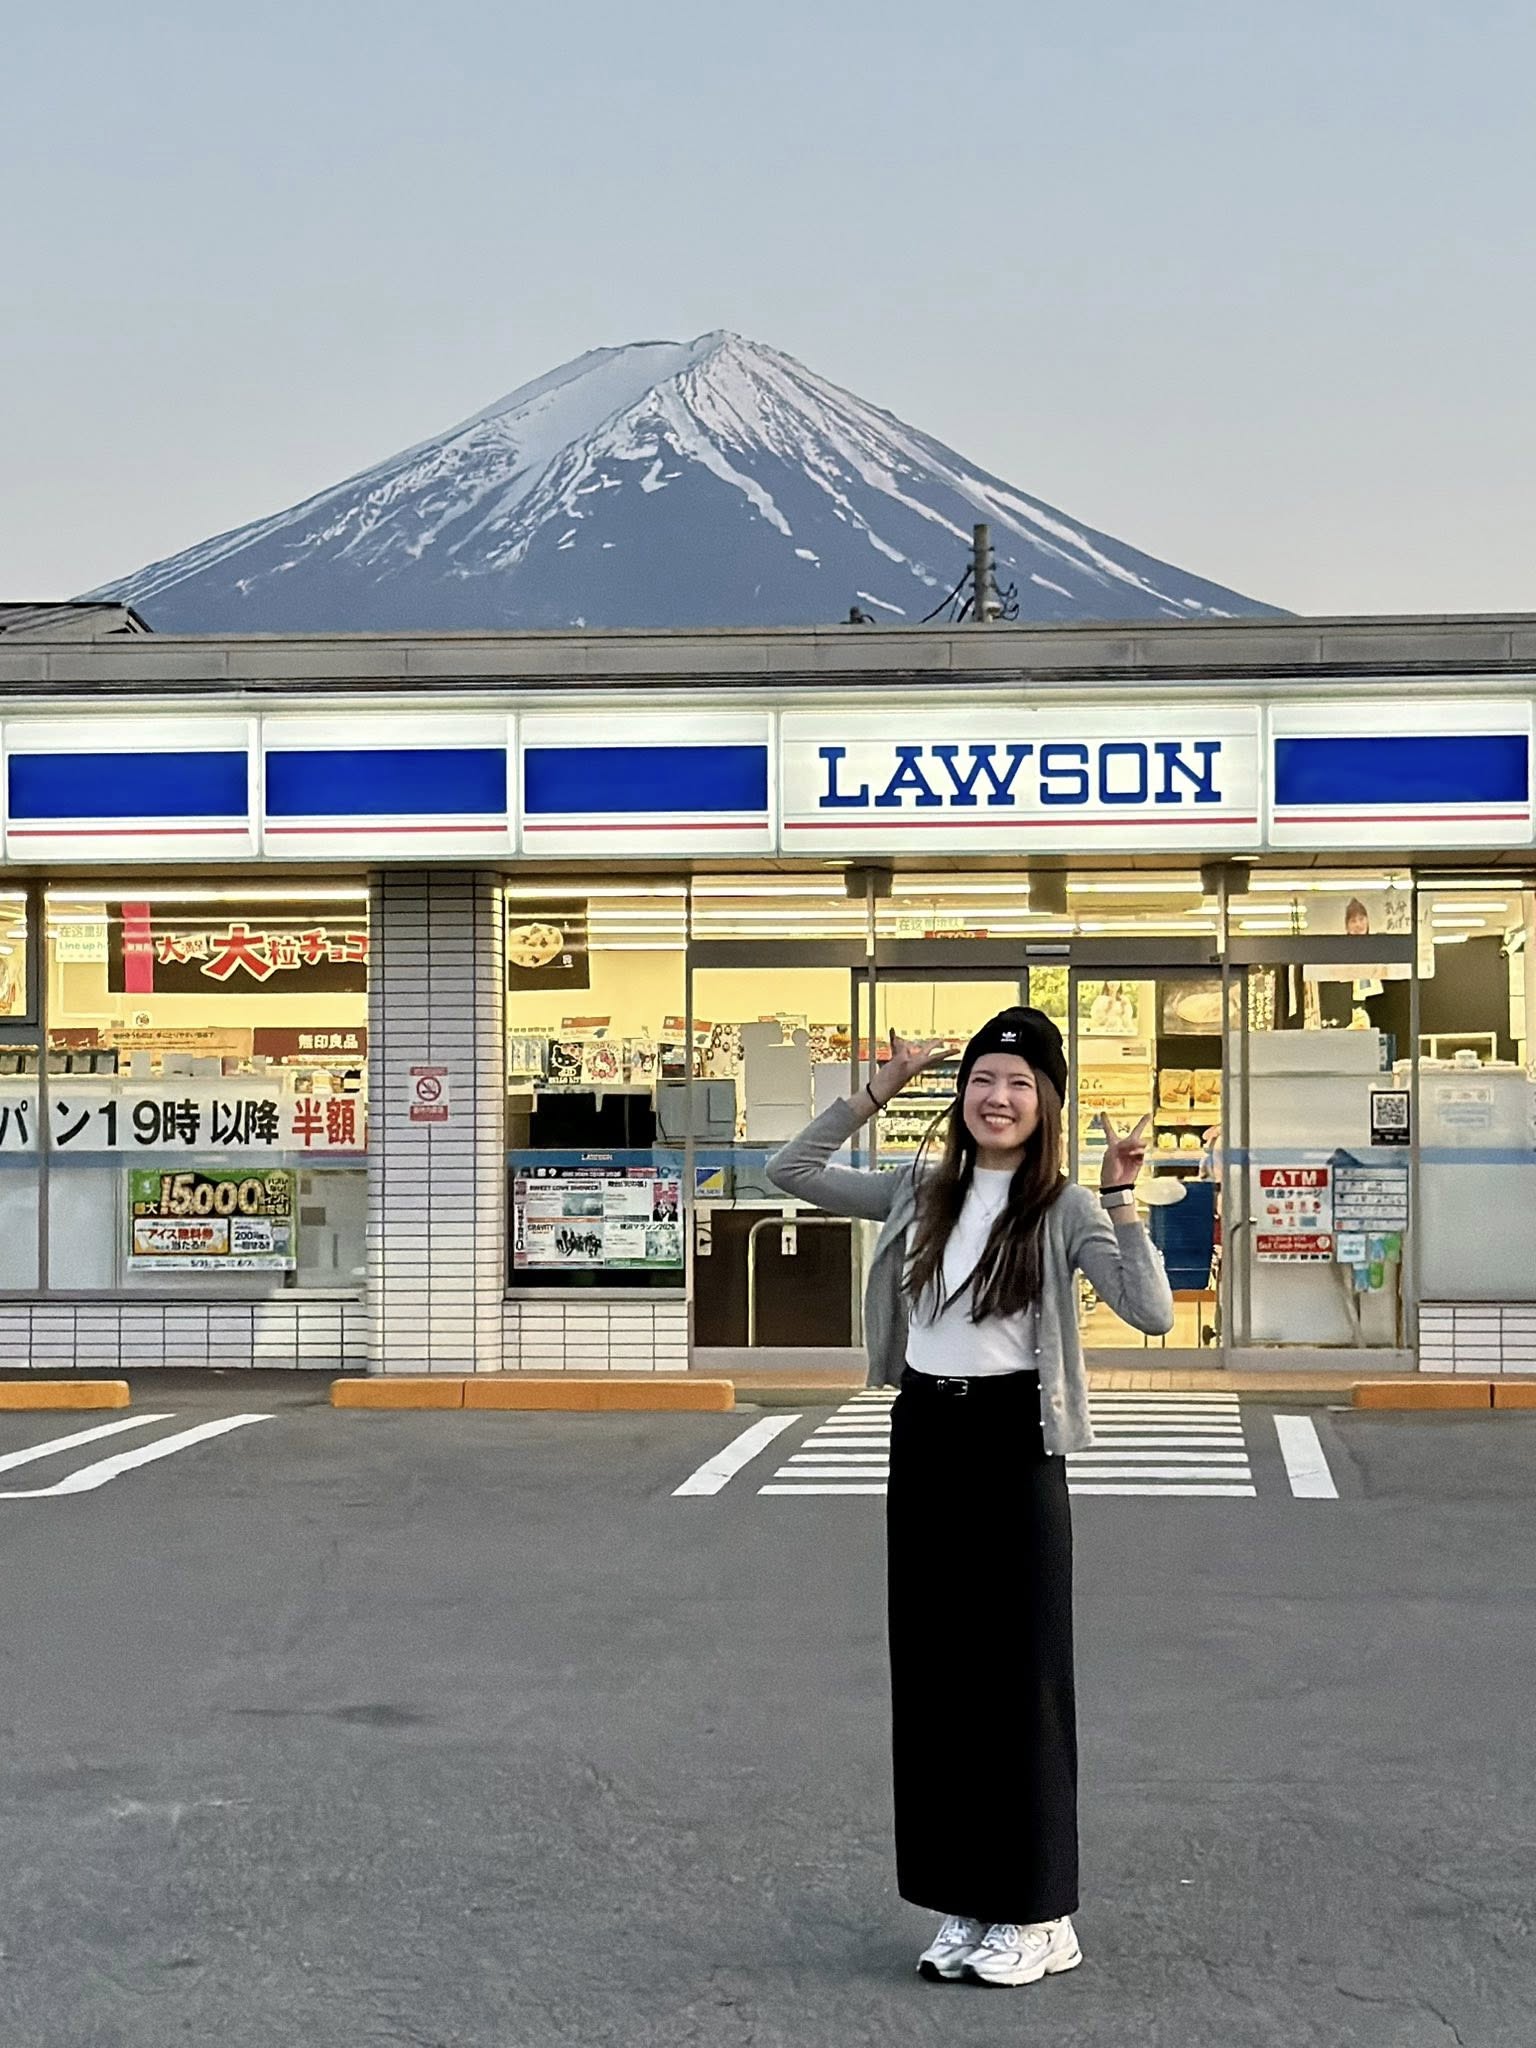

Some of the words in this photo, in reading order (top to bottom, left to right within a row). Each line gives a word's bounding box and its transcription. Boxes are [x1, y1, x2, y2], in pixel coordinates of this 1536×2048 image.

[819, 741, 1222, 807] LAWSON
[298, 1033, 358, 1049] 無印良品
[1271, 1170, 1317, 1186] ATM
